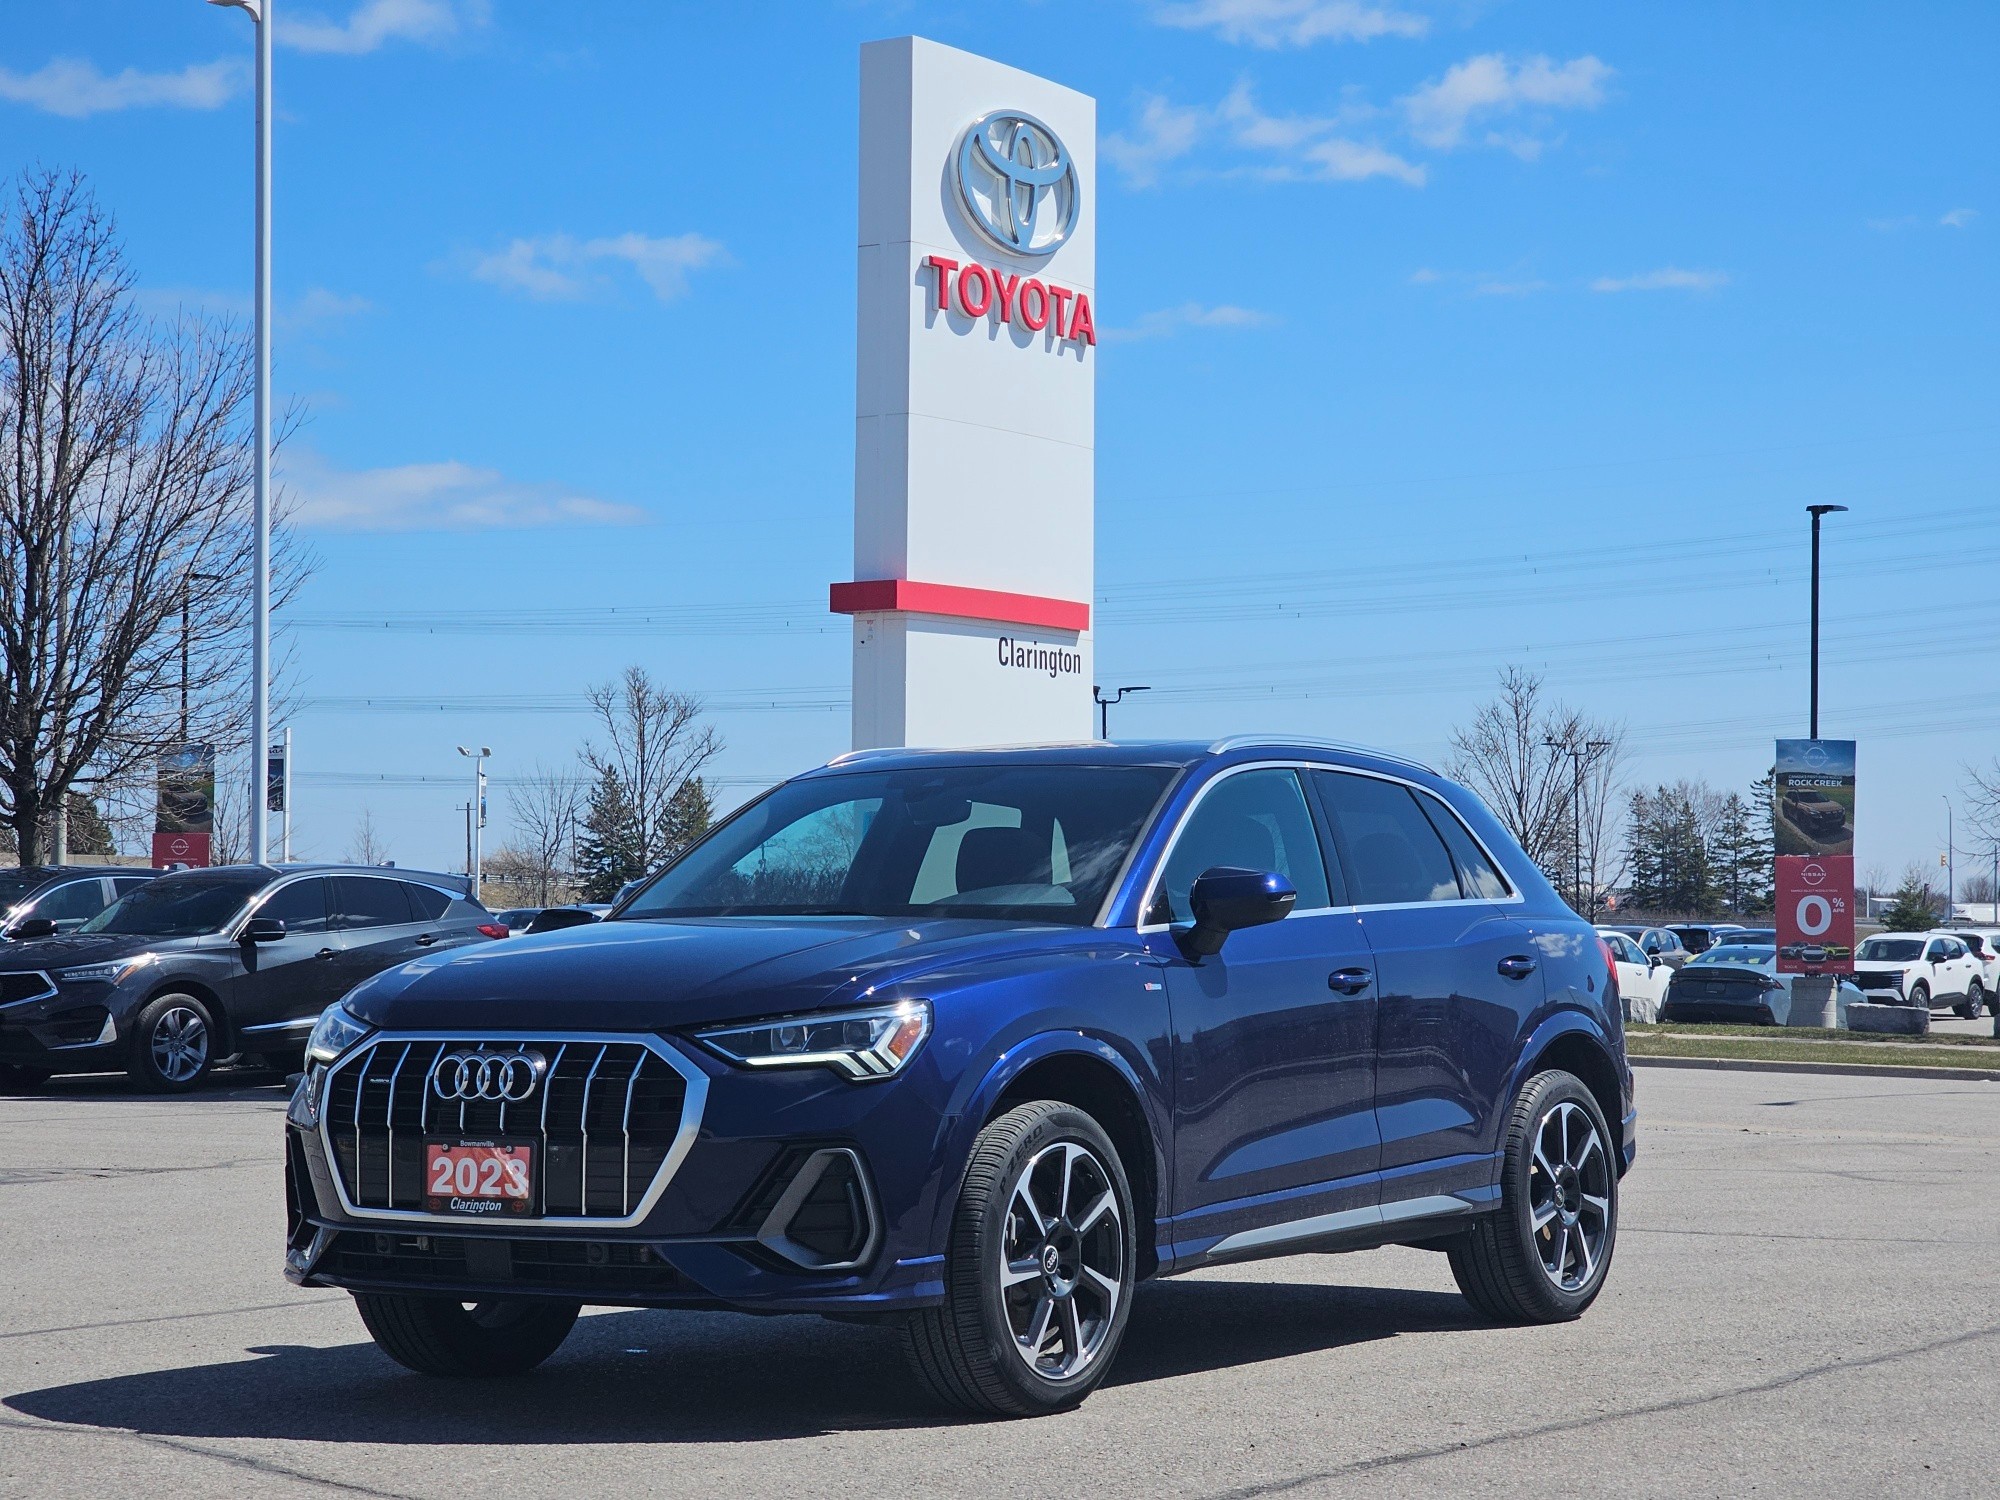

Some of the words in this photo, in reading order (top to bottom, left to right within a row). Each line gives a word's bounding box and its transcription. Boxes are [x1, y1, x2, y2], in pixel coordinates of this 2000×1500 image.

[924, 255, 1096, 346] TOYOTA
[998, 636, 1081, 678] Clarington
[1814, 779, 1842, 787] CREEK
[1007, 1124, 1042, 1176] ZERO
[431, 1156, 528, 1197] 2023
[450, 1196, 502, 1213] Clarington
